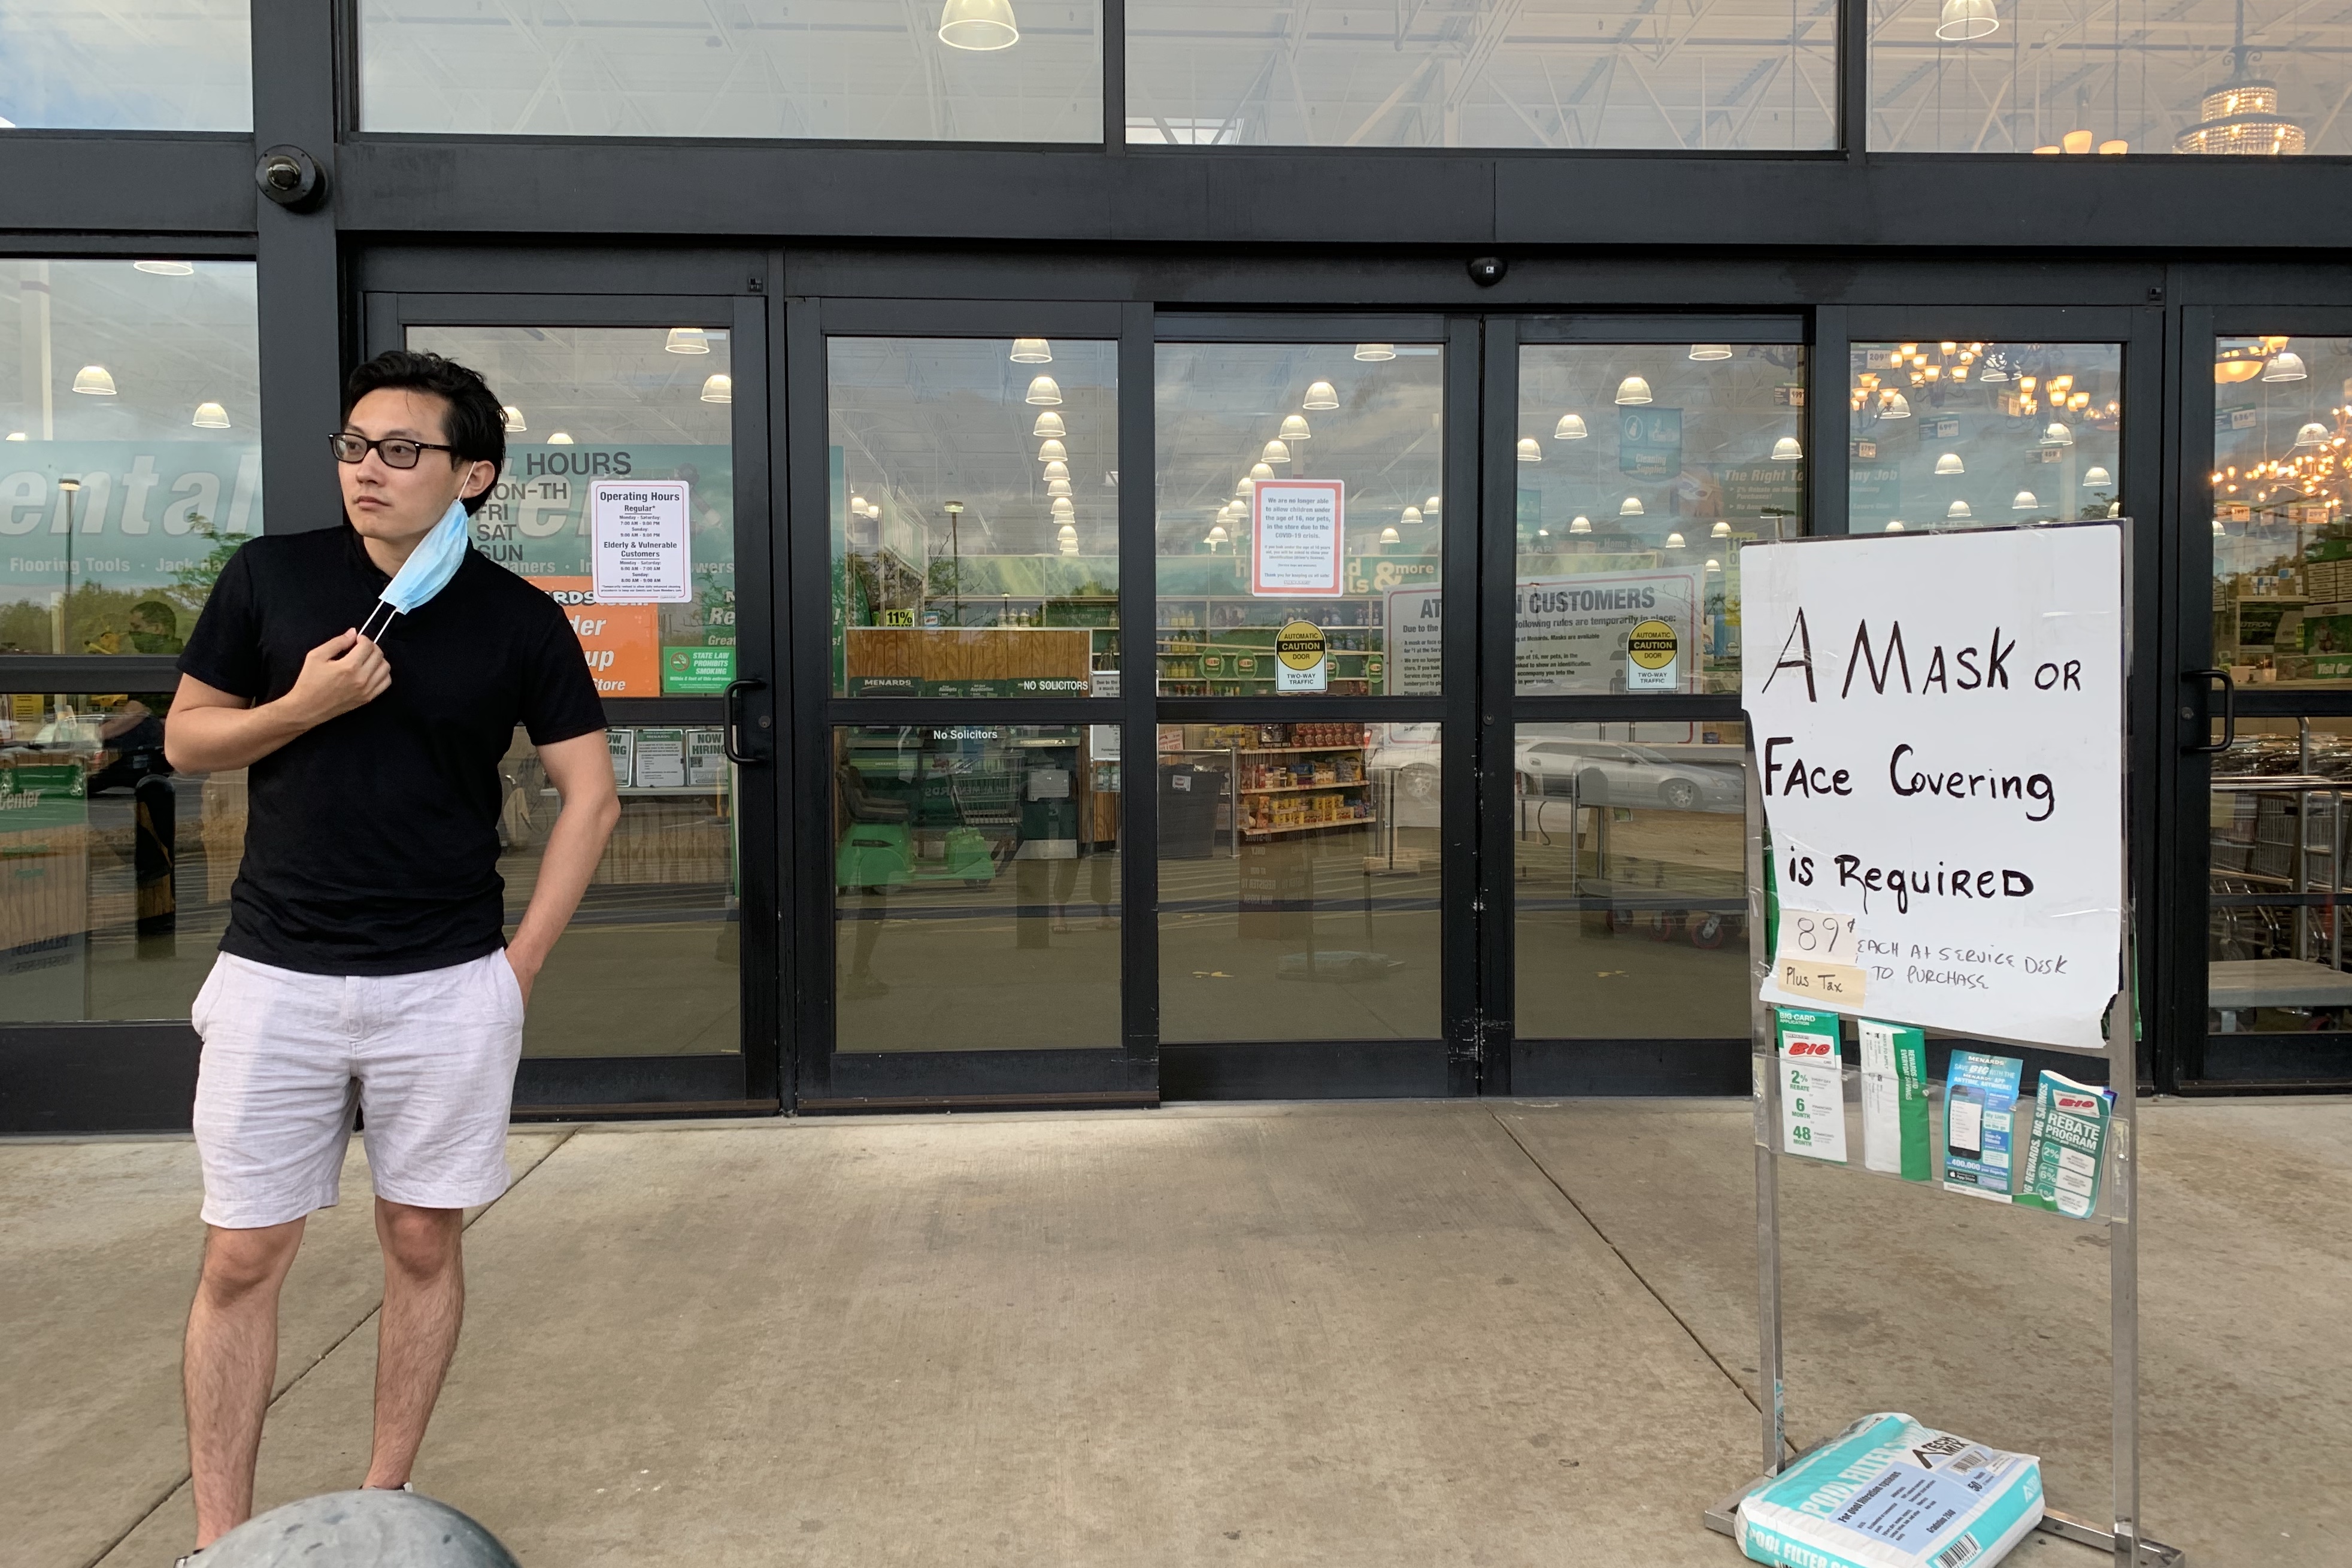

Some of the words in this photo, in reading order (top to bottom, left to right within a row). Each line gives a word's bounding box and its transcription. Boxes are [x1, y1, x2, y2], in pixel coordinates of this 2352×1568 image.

[527, 452, 631, 475] HOURS
[1636, 454, 1666, 465] Cleaning
[1636, 465, 1666, 476] Supplies
[1724, 469, 1747, 482] The
[1752, 469, 1786, 483] Right
[488, 483, 566, 500] ON-TH
[601, 492, 647, 502] Operating
[651, 492, 680, 501] Hours
[476, 504, 508, 520] FRI
[477, 524, 516, 541] SAT
[1605, 539, 1627, 548] Home
[477, 545, 523, 562] SUN
[10, 558, 80, 574] Flooring
[86, 558, 130, 572] Tools
[156, 558, 193, 572] Jack
[1395, 565, 1434, 574] more
[1529, 587, 1655, 613] CUSTOMERS
[887, 612, 913, 624] 11%
[1762, 606, 1817, 703] A
[1842, 618, 2015, 699] MASK
[2035, 660, 2081, 691] OR
[2317, 663, 2335, 674] Visit
[2337, 663, 2351, 674] Our
[1024, 681, 1036, 690] NO
[1039, 681, 1088, 690] SOLICITORS
[698, 734, 722, 743] NOW
[933, 730, 947, 739] No
[950, 729, 998, 739] Solicitors
[1890, 744, 2056, 821] Covering
[1789, 846, 1814, 886] is
[1857, 940, 1899, 957] EACH
[1939, 947, 2014, 967] SERVICE
[2024, 956, 2068, 974] DESK
[1786, 967, 1809, 987] Plus
[1818, 975, 1843, 993] Tax
[1872, 966, 1893, 979] TO
[1908, 966, 1989, 990] PURCHASE
[1793, 1013, 1815, 1022] CARD
[1789, 1042, 1830, 1055] BIG
[1900, 1050, 1910, 1076] EVERYDAY
[1908, 1050, 1917, 1080] REWARDS
[1954, 1063, 1968, 1072] SAVE
[1969, 1065, 1989, 1075] BIG
[1968, 1056, 2004, 1066] MENARDS
[1792, 1070, 1808, 1084] 2%
[1954, 1077, 1979, 1087] ANYTIME,
[1980, 1082, 2012, 1091] ANYWHERE!
[1796, 1098, 1805, 1112] 6
[2036, 1082, 2048, 1119] SAVINGS.
[1793, 1126, 1811, 1141] 48
[2033, 1120, 2044, 1137] BIG
[2048, 1112, 2101, 1141] REBATE
[2045, 1125, 2097, 1150] PROGRAM
[2043, 1147, 2059, 1159] 2%
[1952, 1158, 1980, 1170] 400,000
[2026, 1139, 2041, 1184] REWARDS.
[2040, 1171, 2056, 1183] 6%
[1942, 1440, 1969, 1456] MIX
[1968, 1481, 1983, 1492] 50
[1798, 1481, 1854, 1520] POOL
[1838, 1514, 1851, 1523] For
[1851, 1501, 1863, 1515] pool
[1857, 1485, 1884, 1505] filtration
[1879, 1471, 1902, 1488] systems
[1748, 1528, 1781, 1555] POOL
[1784, 1543, 1828, 1568] FILTER
